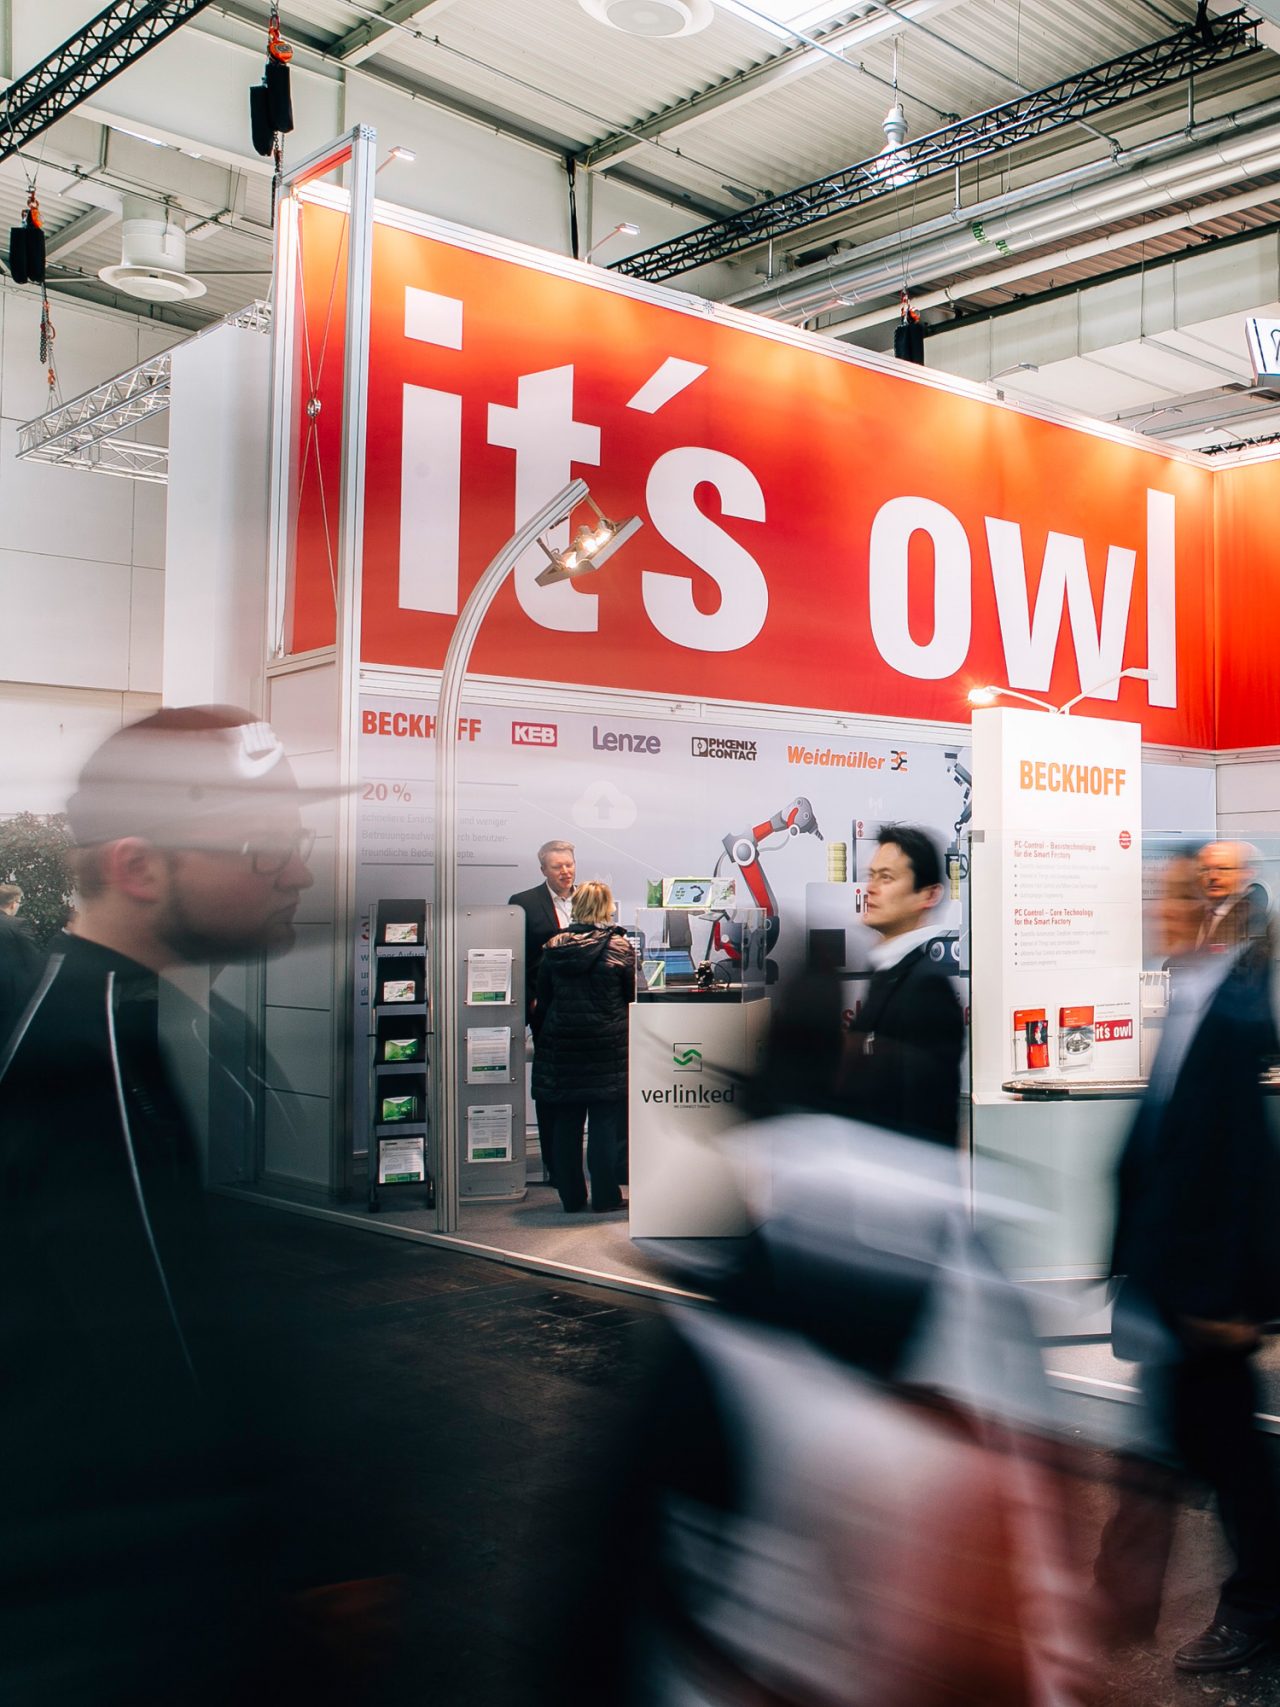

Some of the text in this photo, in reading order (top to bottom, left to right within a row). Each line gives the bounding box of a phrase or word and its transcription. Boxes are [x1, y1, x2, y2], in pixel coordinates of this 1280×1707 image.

[869, 487, 1177, 709] owl
[362, 710, 482, 741] BECKHFF
[514, 724, 556, 744] KEB
[592, 725, 661, 755] Lenze
[708, 749, 757, 761] CONTACT
[787, 745, 886, 769] Weidmüller
[1019, 760, 1126, 796] BECKHOFF
[362, 783, 412, 802] 20 %
[361, 830, 434, 842] Betreuungsaufwa
[1014, 908, 1022, 917] PC
[1024, 908, 1045, 917] Control
[1050, 908, 1063, 917] Core
[1064, 908, 1094, 918] Technology
[1014, 917, 1072, 927] for the Smart Factory
[1113, 1021, 1132, 1038] owl
[641, 1084, 735, 1104] verlinked
